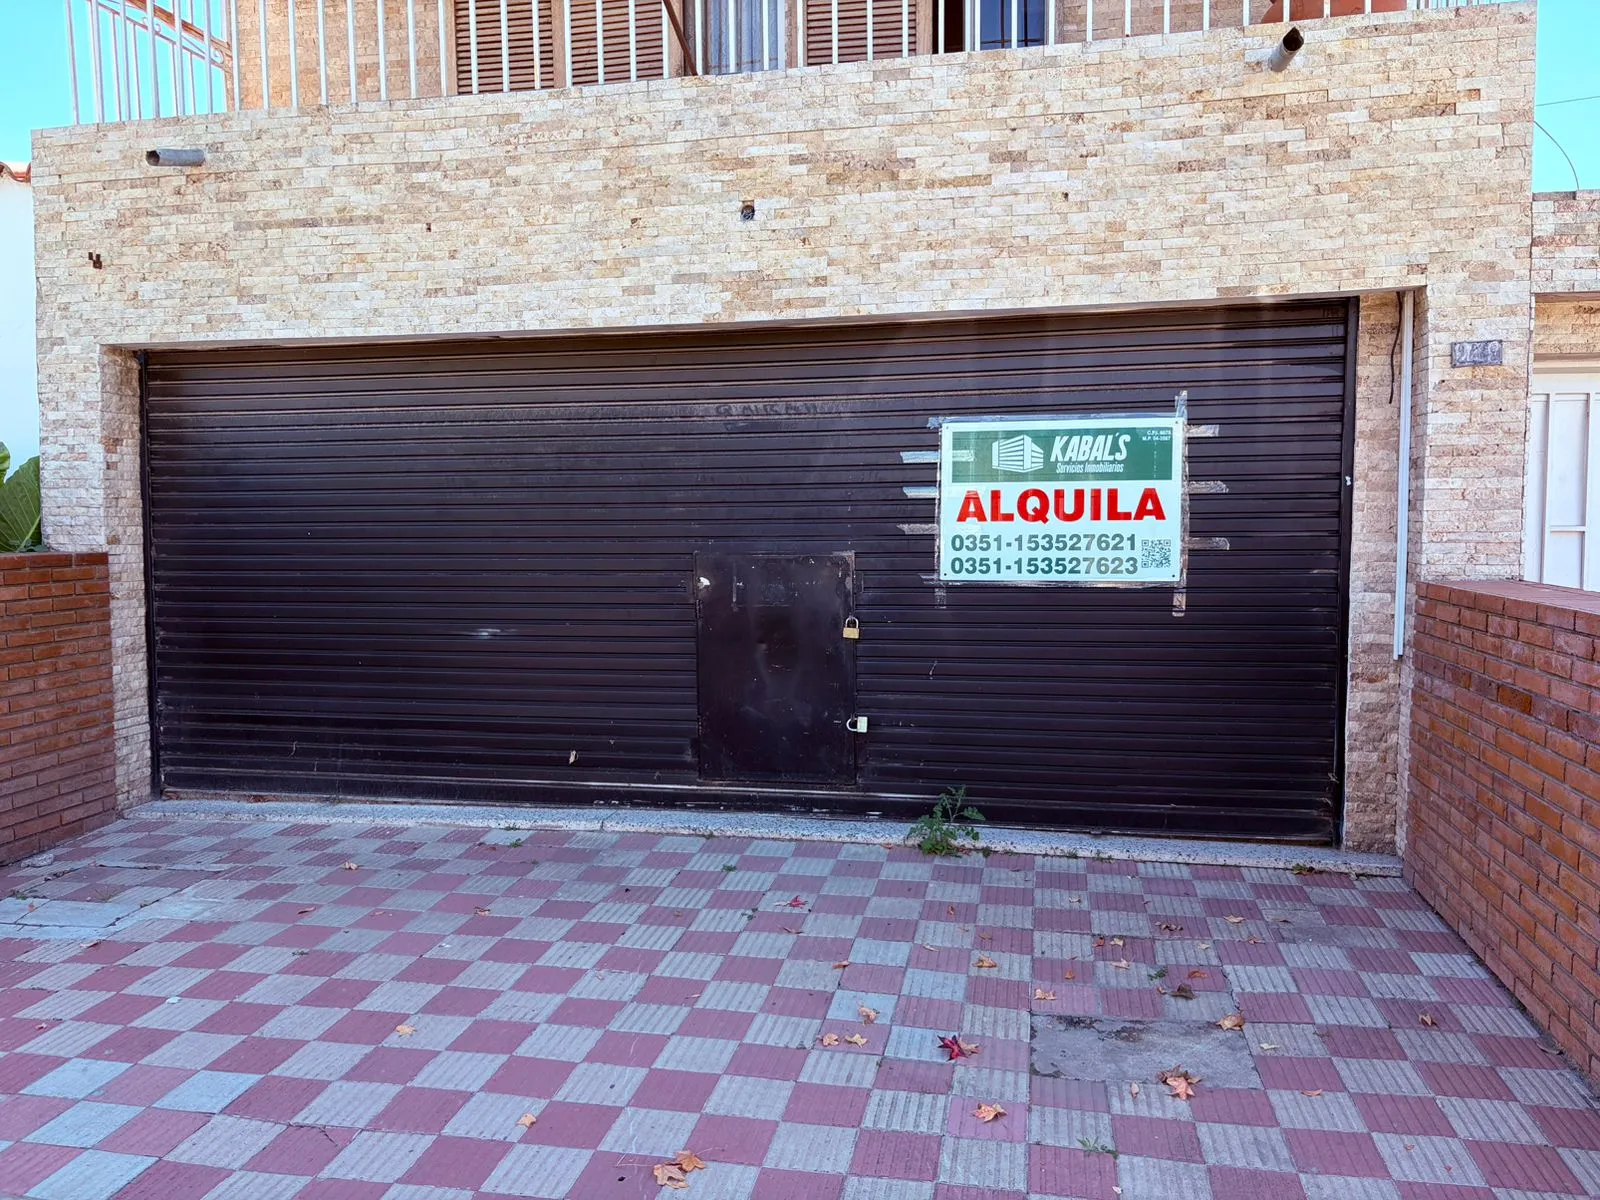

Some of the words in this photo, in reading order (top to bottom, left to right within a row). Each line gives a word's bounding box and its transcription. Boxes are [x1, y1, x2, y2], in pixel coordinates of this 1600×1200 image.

[1056, 462, 1084, 474] Servicios
[1084, 461, 1124, 473] Inmobiliarios
[956, 487, 1166, 525] ALQUILA
[951, 533, 1136, 551] 0351-153527621
[951, 557, 1138, 574] 0351-153527623
